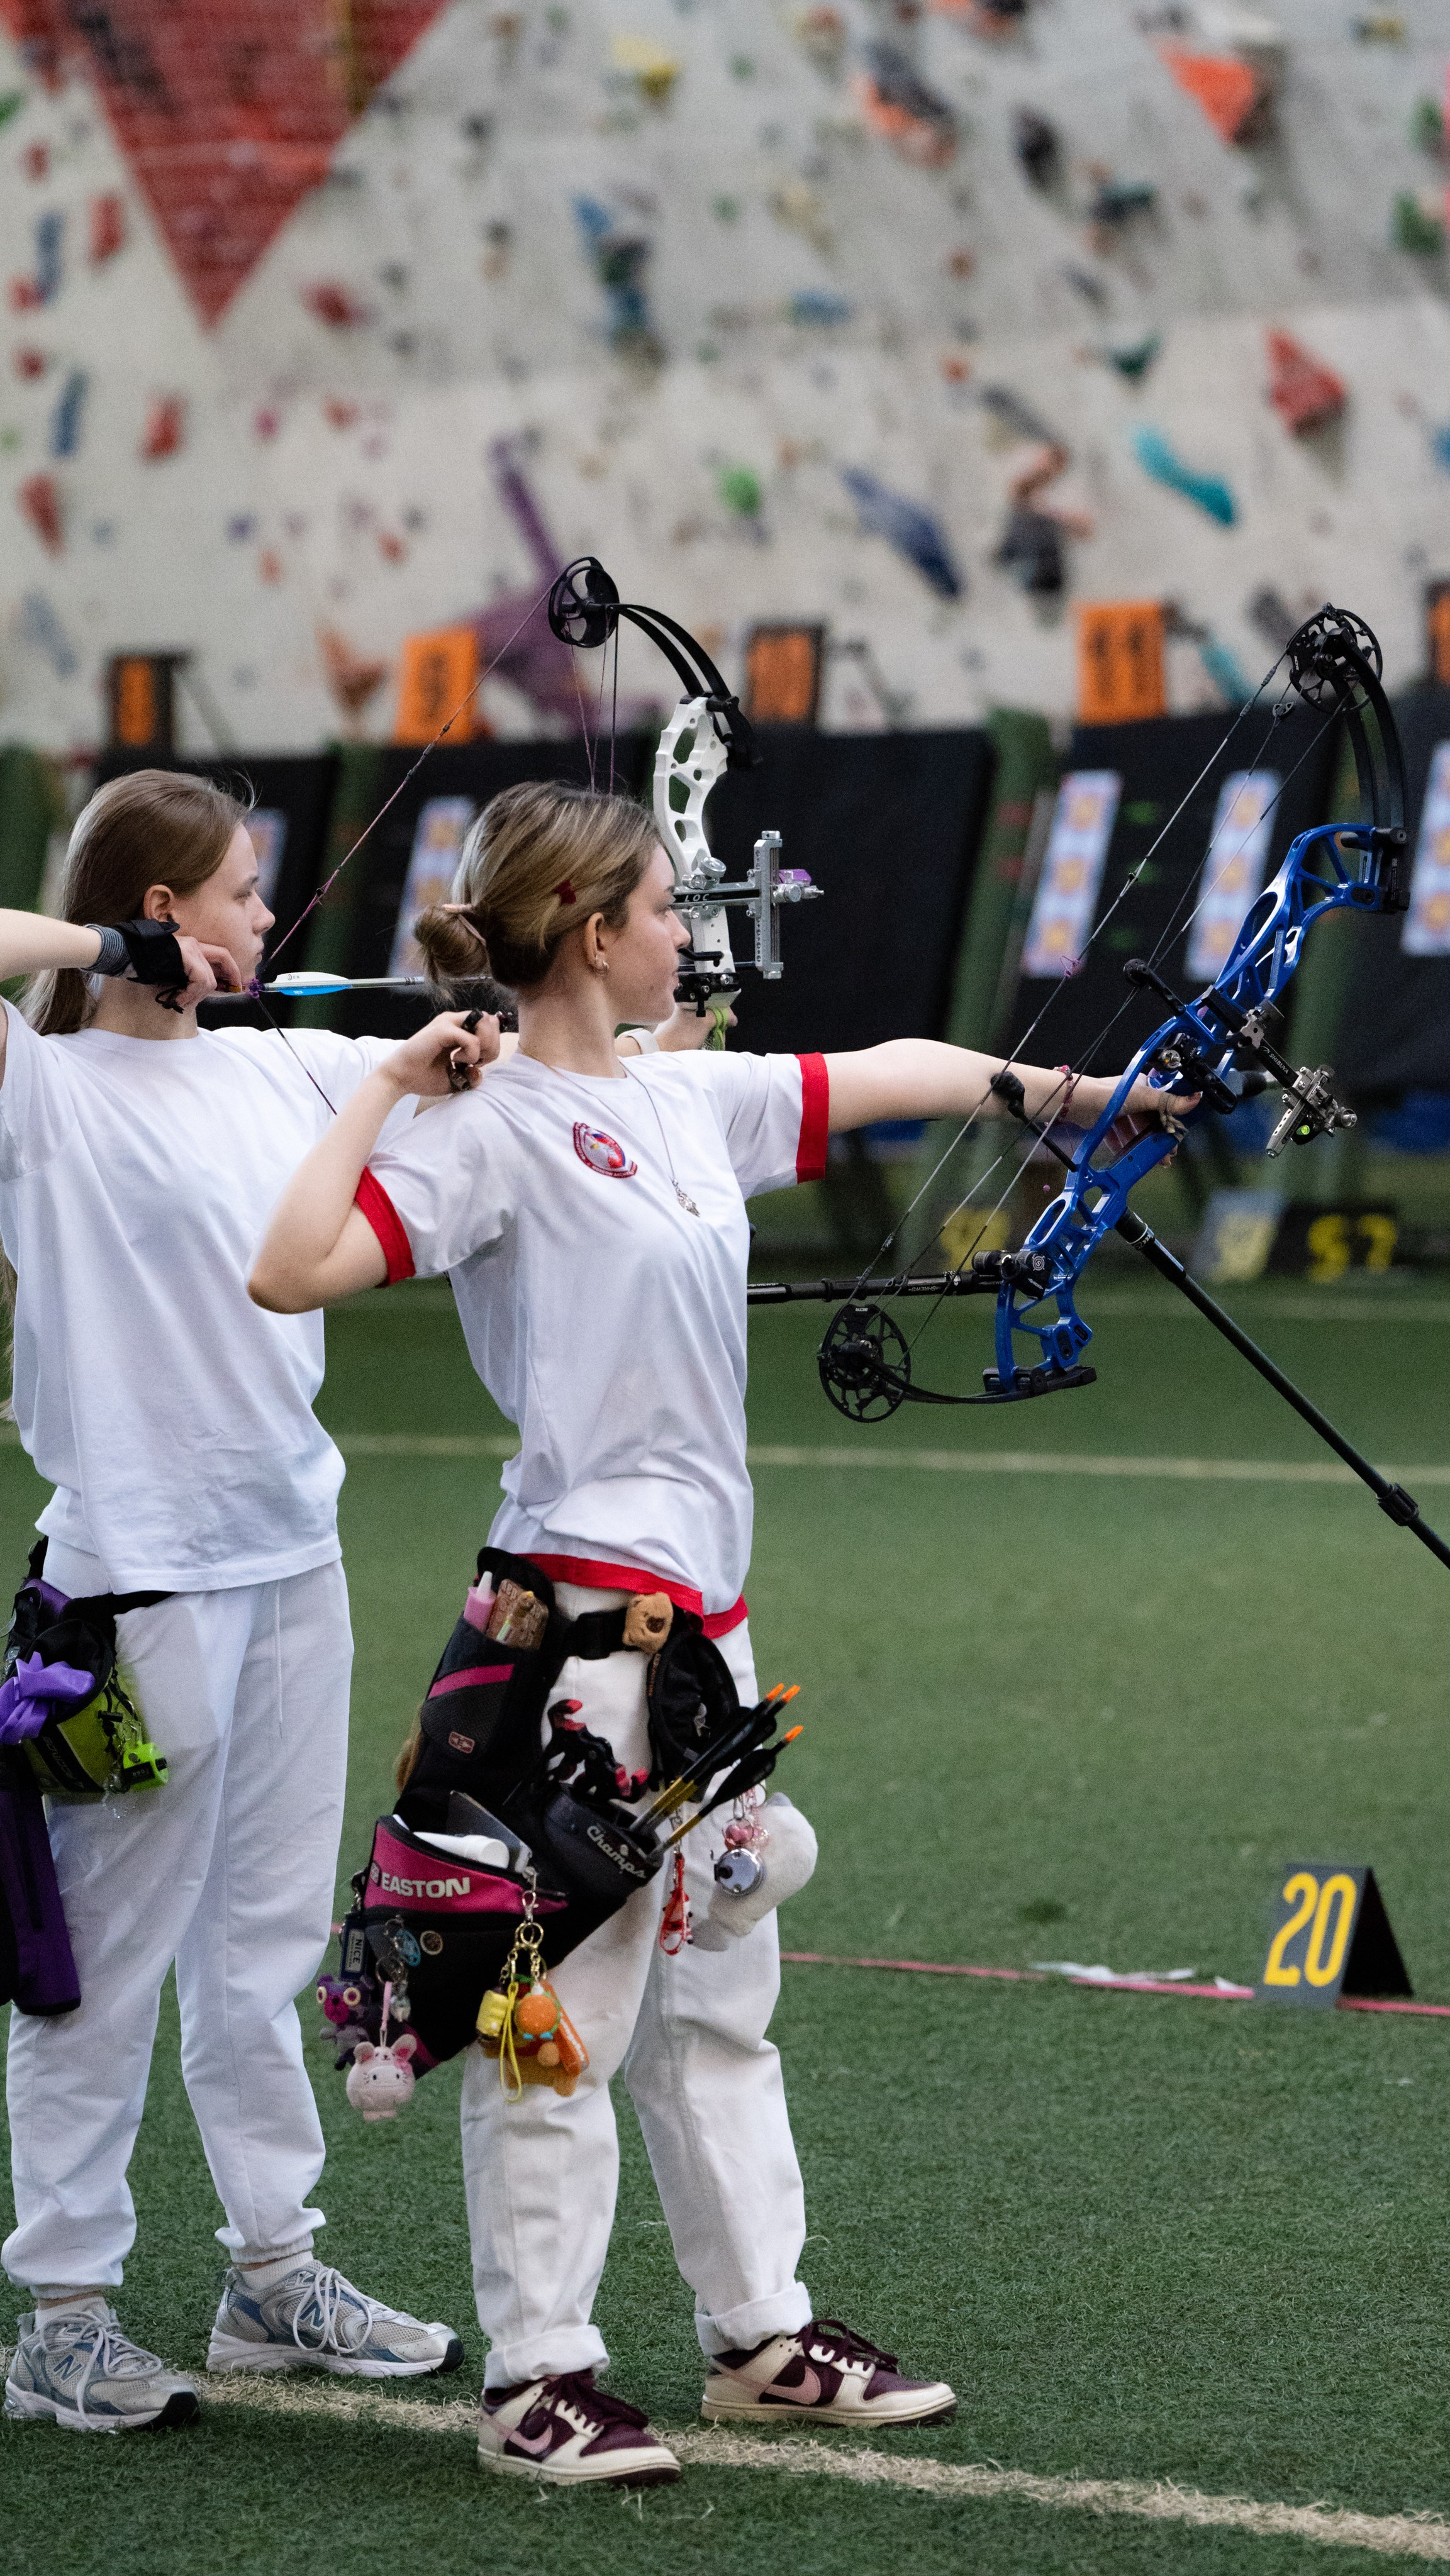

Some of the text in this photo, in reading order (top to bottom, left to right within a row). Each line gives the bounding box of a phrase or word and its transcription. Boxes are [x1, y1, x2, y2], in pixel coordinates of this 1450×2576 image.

[684, 894, 710, 902] LOC
[1269, 1053, 1289, 1074] SHIBUYA
[587, 1826, 646, 1879] Champs
[382, 1872, 470, 1898] EASTON
[1263, 1872, 1356, 1987] 20
[353, 1939, 363, 1963] NICE
[53, 2354, 82, 2381] N
